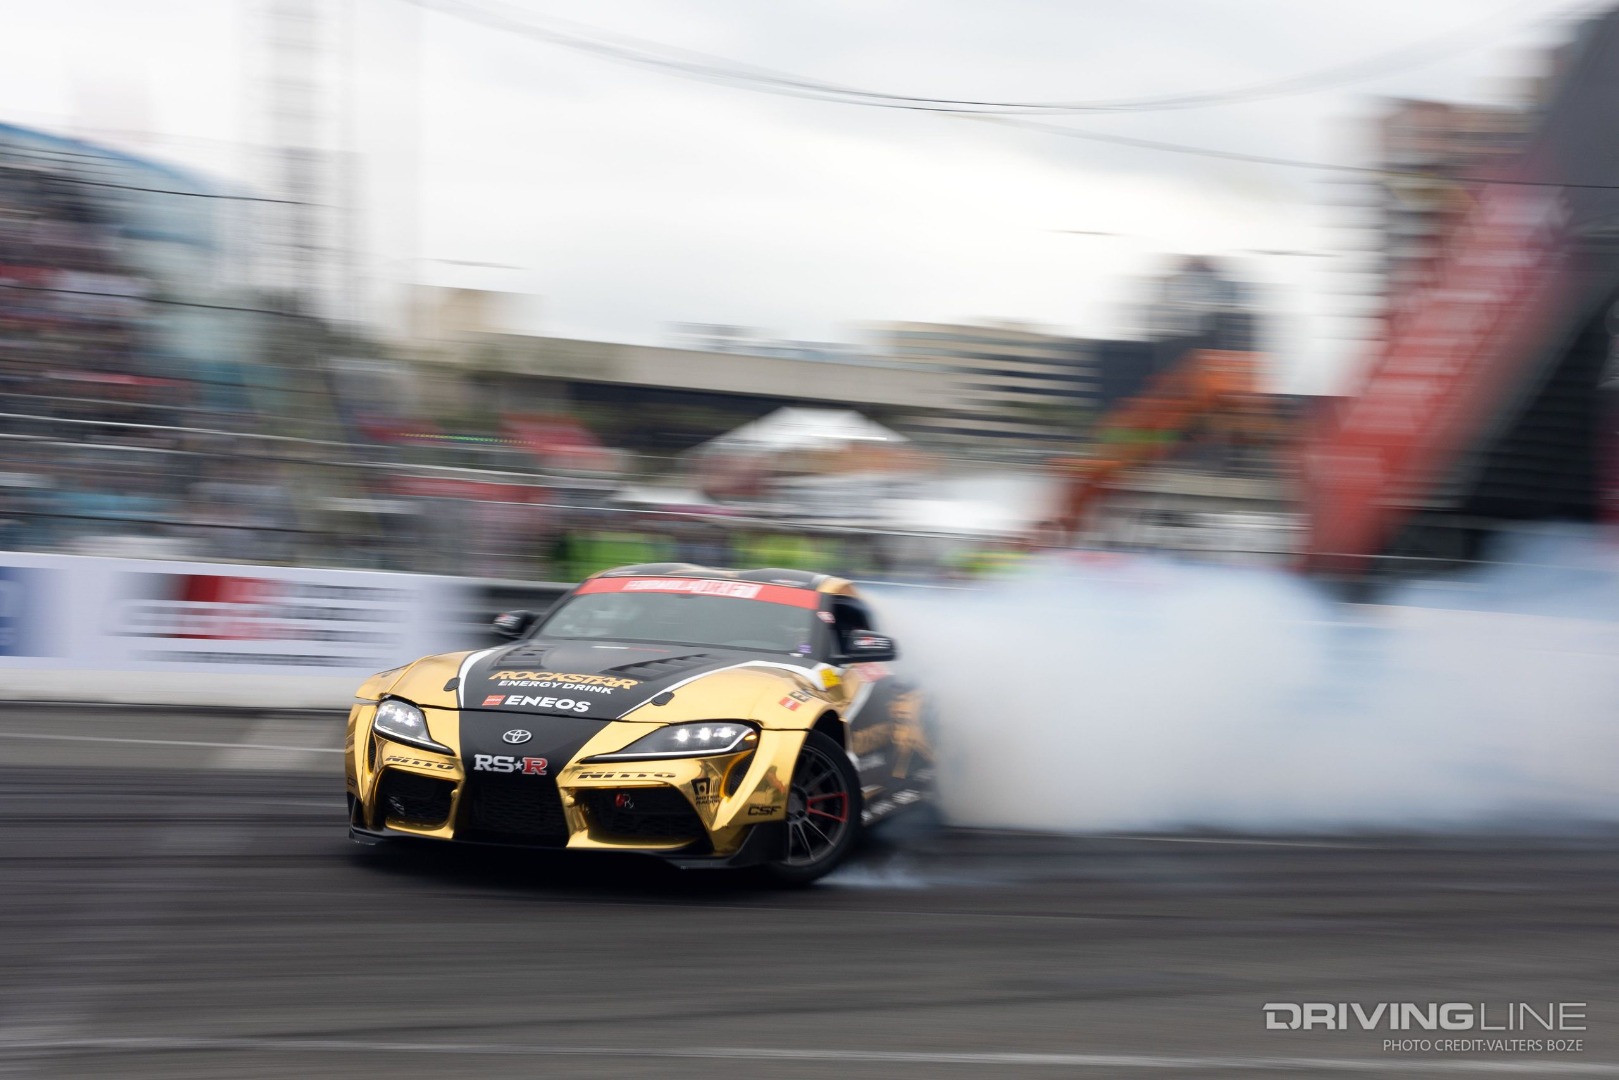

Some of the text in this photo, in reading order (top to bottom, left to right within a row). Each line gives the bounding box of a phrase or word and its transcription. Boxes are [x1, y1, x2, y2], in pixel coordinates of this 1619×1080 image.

[488, 670, 640, 690] ROCKSTAR
[498, 680, 615, 695] ENERGY DRINK
[504, 695, 592, 713] ENEOS
[385, 755, 456, 770] NITTO
[577, 771, 677, 780] NITTO
[747, 804, 782, 816] CSF
